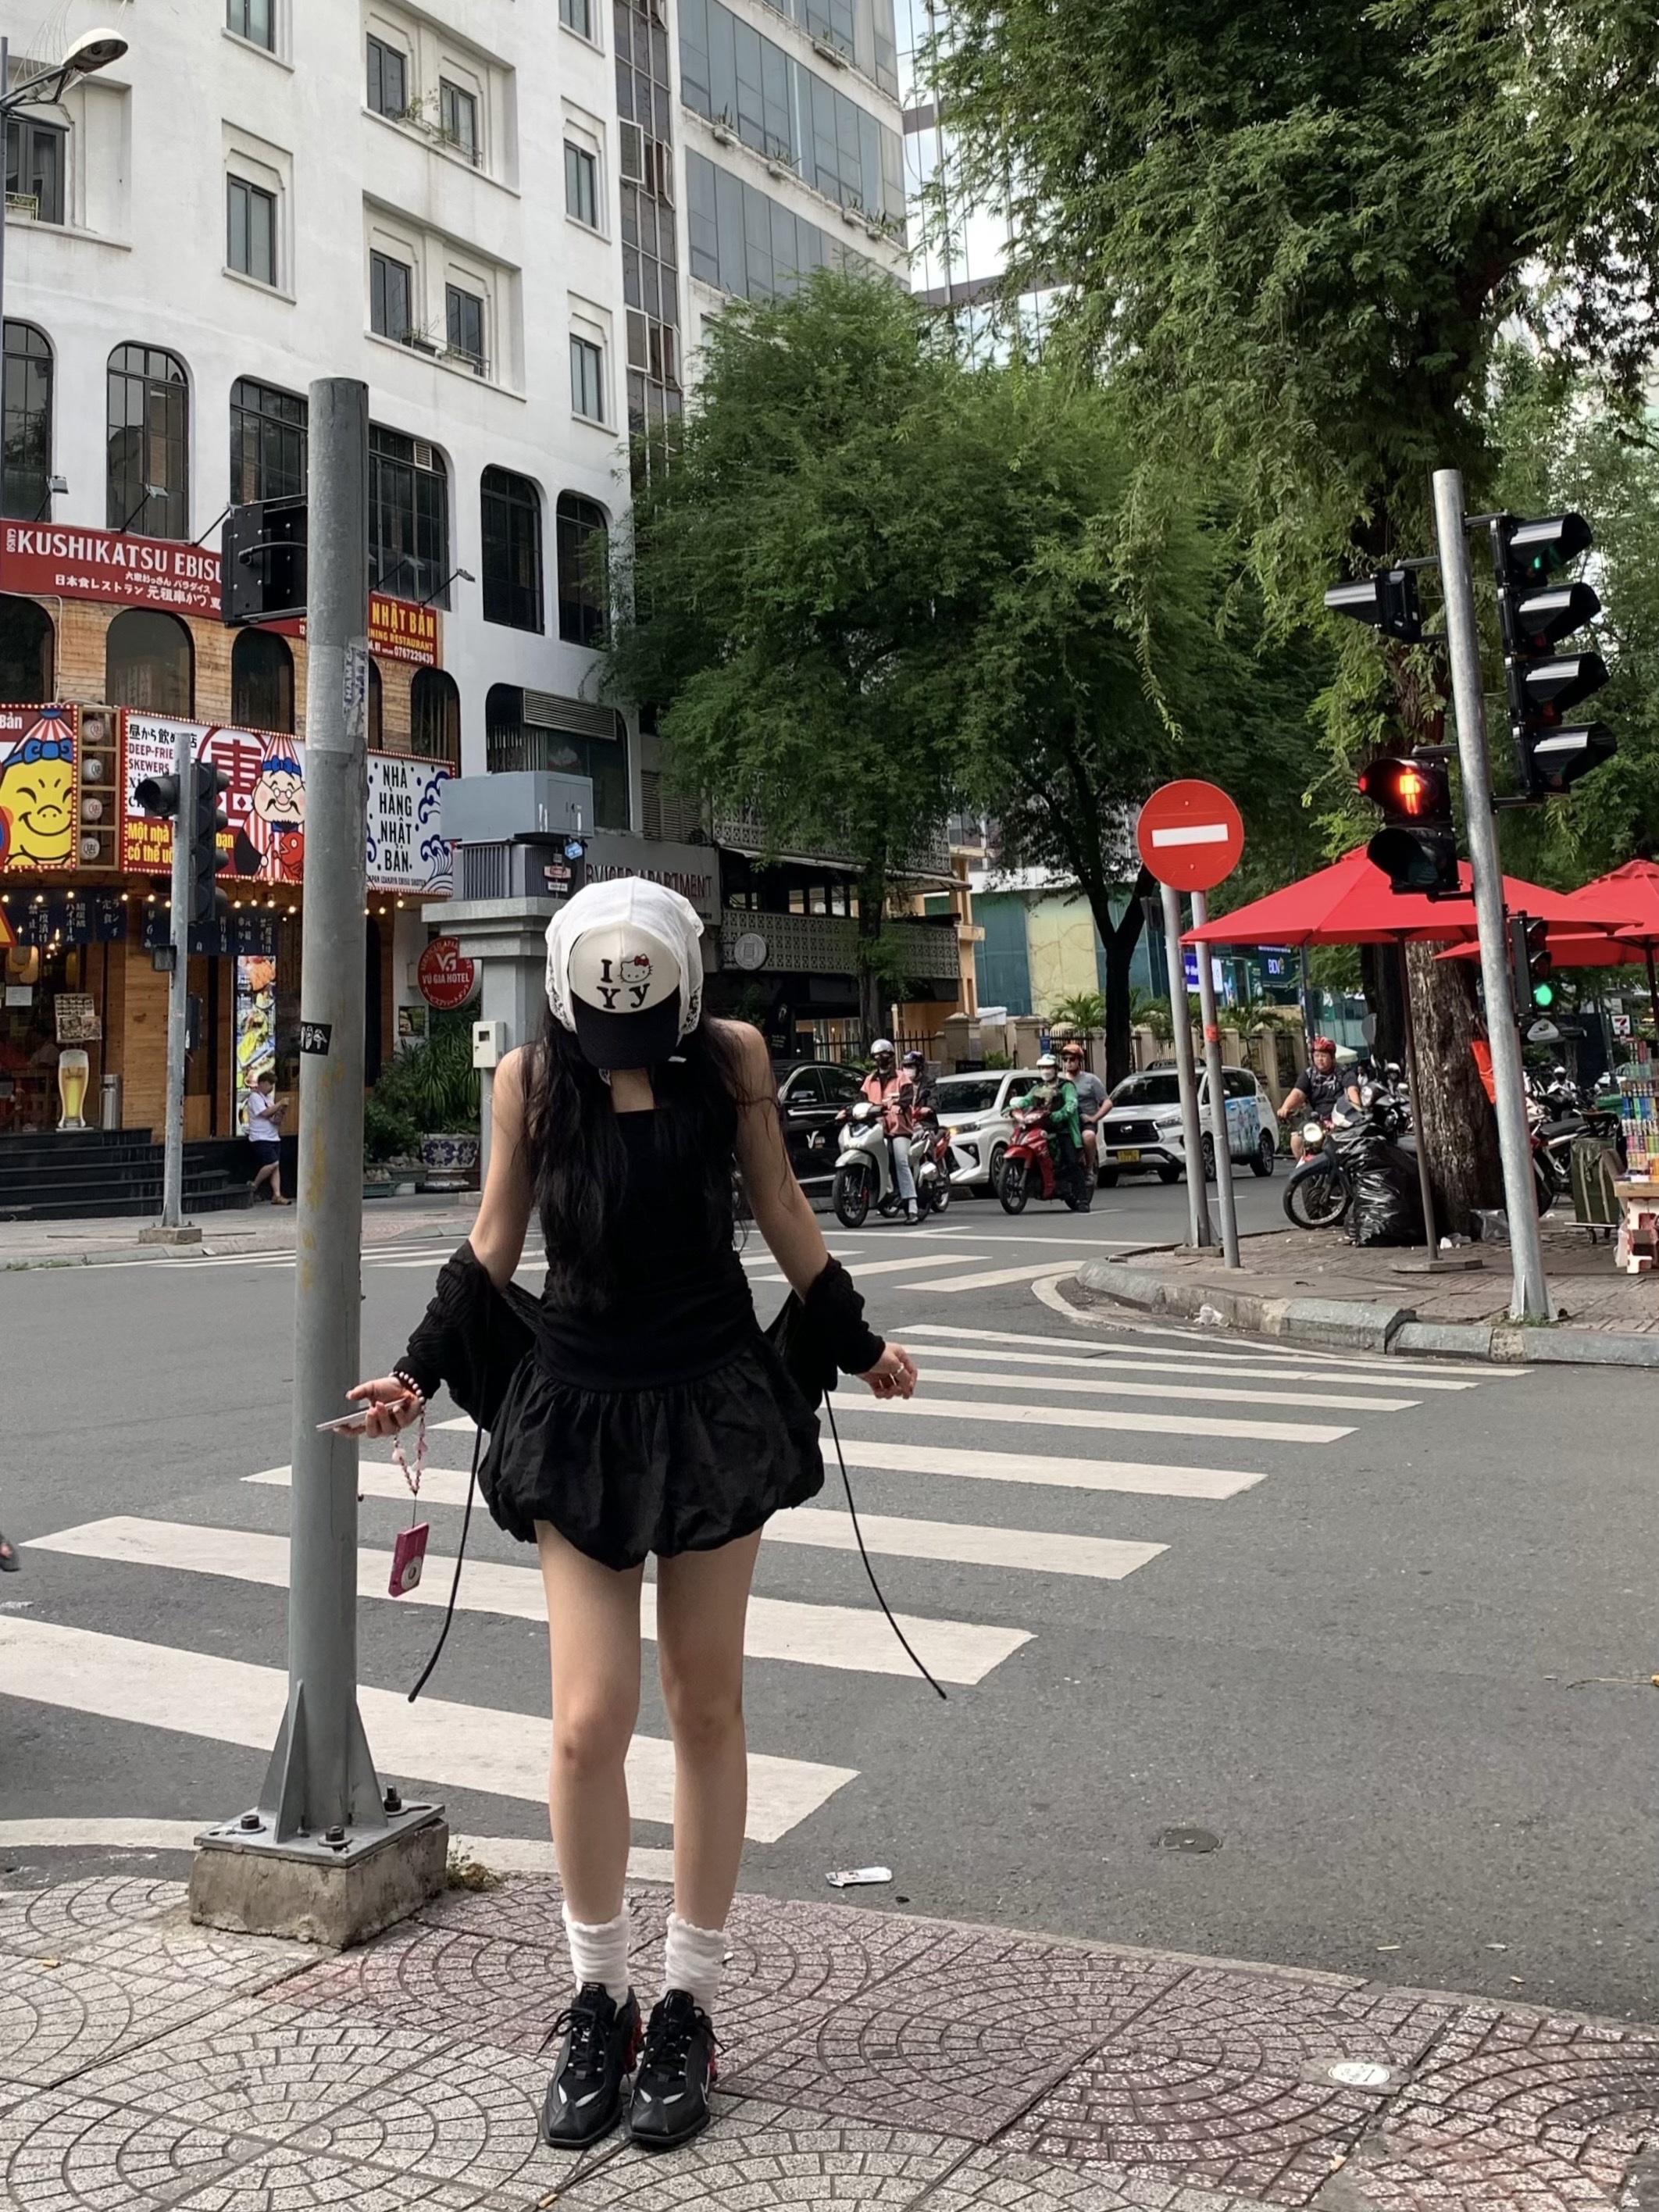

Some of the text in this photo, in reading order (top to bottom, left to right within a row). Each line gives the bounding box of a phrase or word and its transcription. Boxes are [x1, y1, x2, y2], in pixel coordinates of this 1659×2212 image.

[17, 529, 167, 573] KUSHIKATSU
[55, 573, 143, 595] 日本食レストラン
[372, 601, 434, 638] NHẬT BẢN
[390, 633, 433, 652] RESTAURANT
[129, 743, 174, 760] DEEP-FRIE
[129, 758, 169, 776] SKEWERS
[383, 761, 408, 789] NHÀ
[379, 787, 412, 818] HÀNG
[128, 821, 148, 844] Một
[151, 824, 169, 843] nhà
[380, 817, 412, 849] NHẬT
[127, 842, 141, 862] có
[143, 843, 161, 863] thể
[585, 863, 633, 884] RVICE
[433, 974, 446, 984] GIA
[446, 972, 470, 983] HOTEL
[601, 958, 613, 983] I
